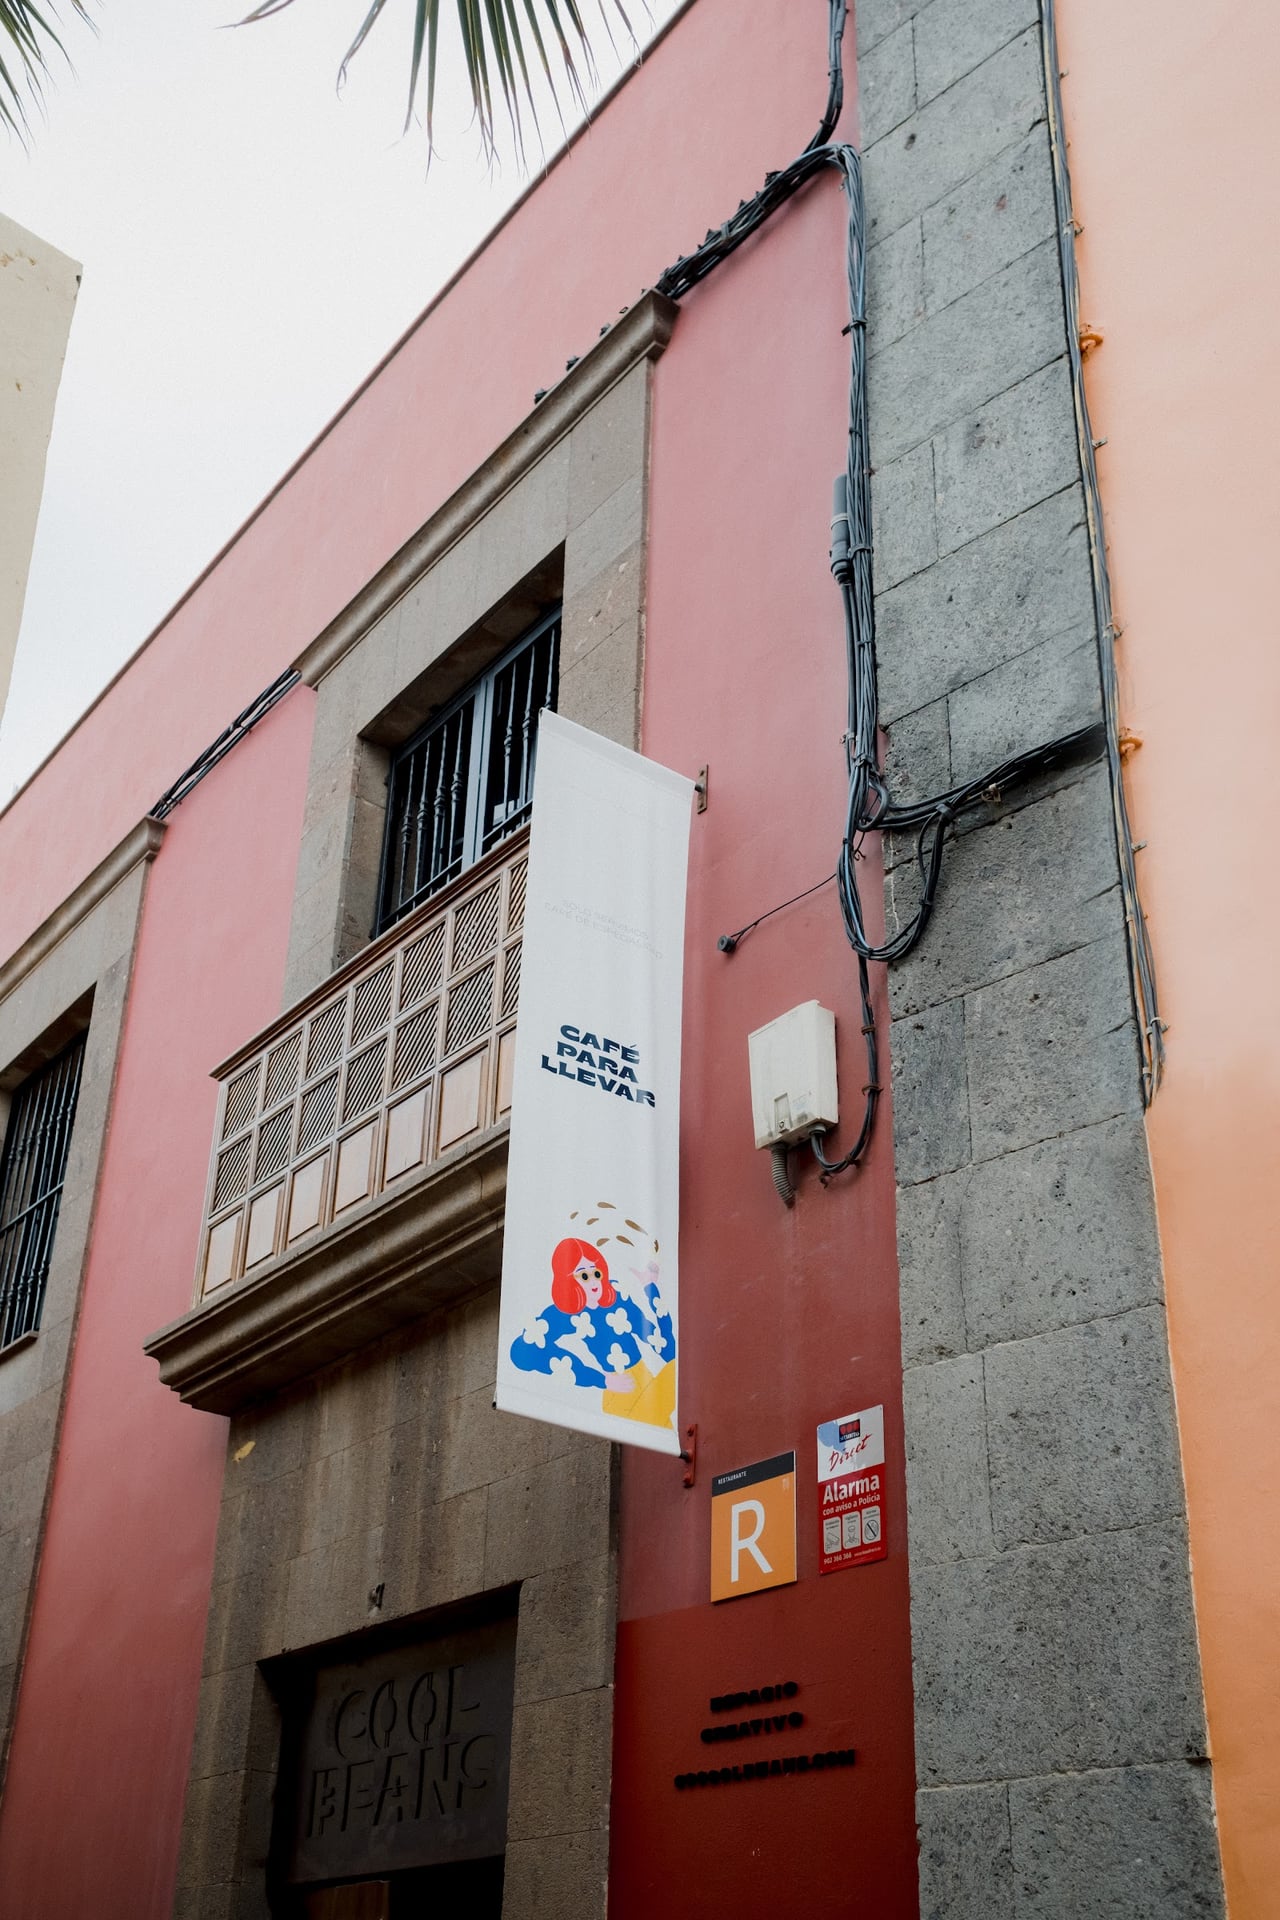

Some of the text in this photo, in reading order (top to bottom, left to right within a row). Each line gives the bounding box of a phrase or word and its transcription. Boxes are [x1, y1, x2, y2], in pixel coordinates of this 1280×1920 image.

[556, 1041, 639, 1083] PARA
[560, 1024, 640, 1065] CAFÉ
[541, 1054, 656, 1108] LLEVAR
[829, 1433, 872, 1472] Direct
[717, 1470, 747, 1485] RESTAURANTE
[823, 1474, 880, 1505] Alarma
[823, 1507, 834, 1516] con
[835, 1501, 852, 1513] aviso
[853, 1500, 858, 1508] a
[730, 1499, 773, 1583] R
[335, 1664, 481, 1759] COOL
[306, 1734, 497, 1838] BEANS
